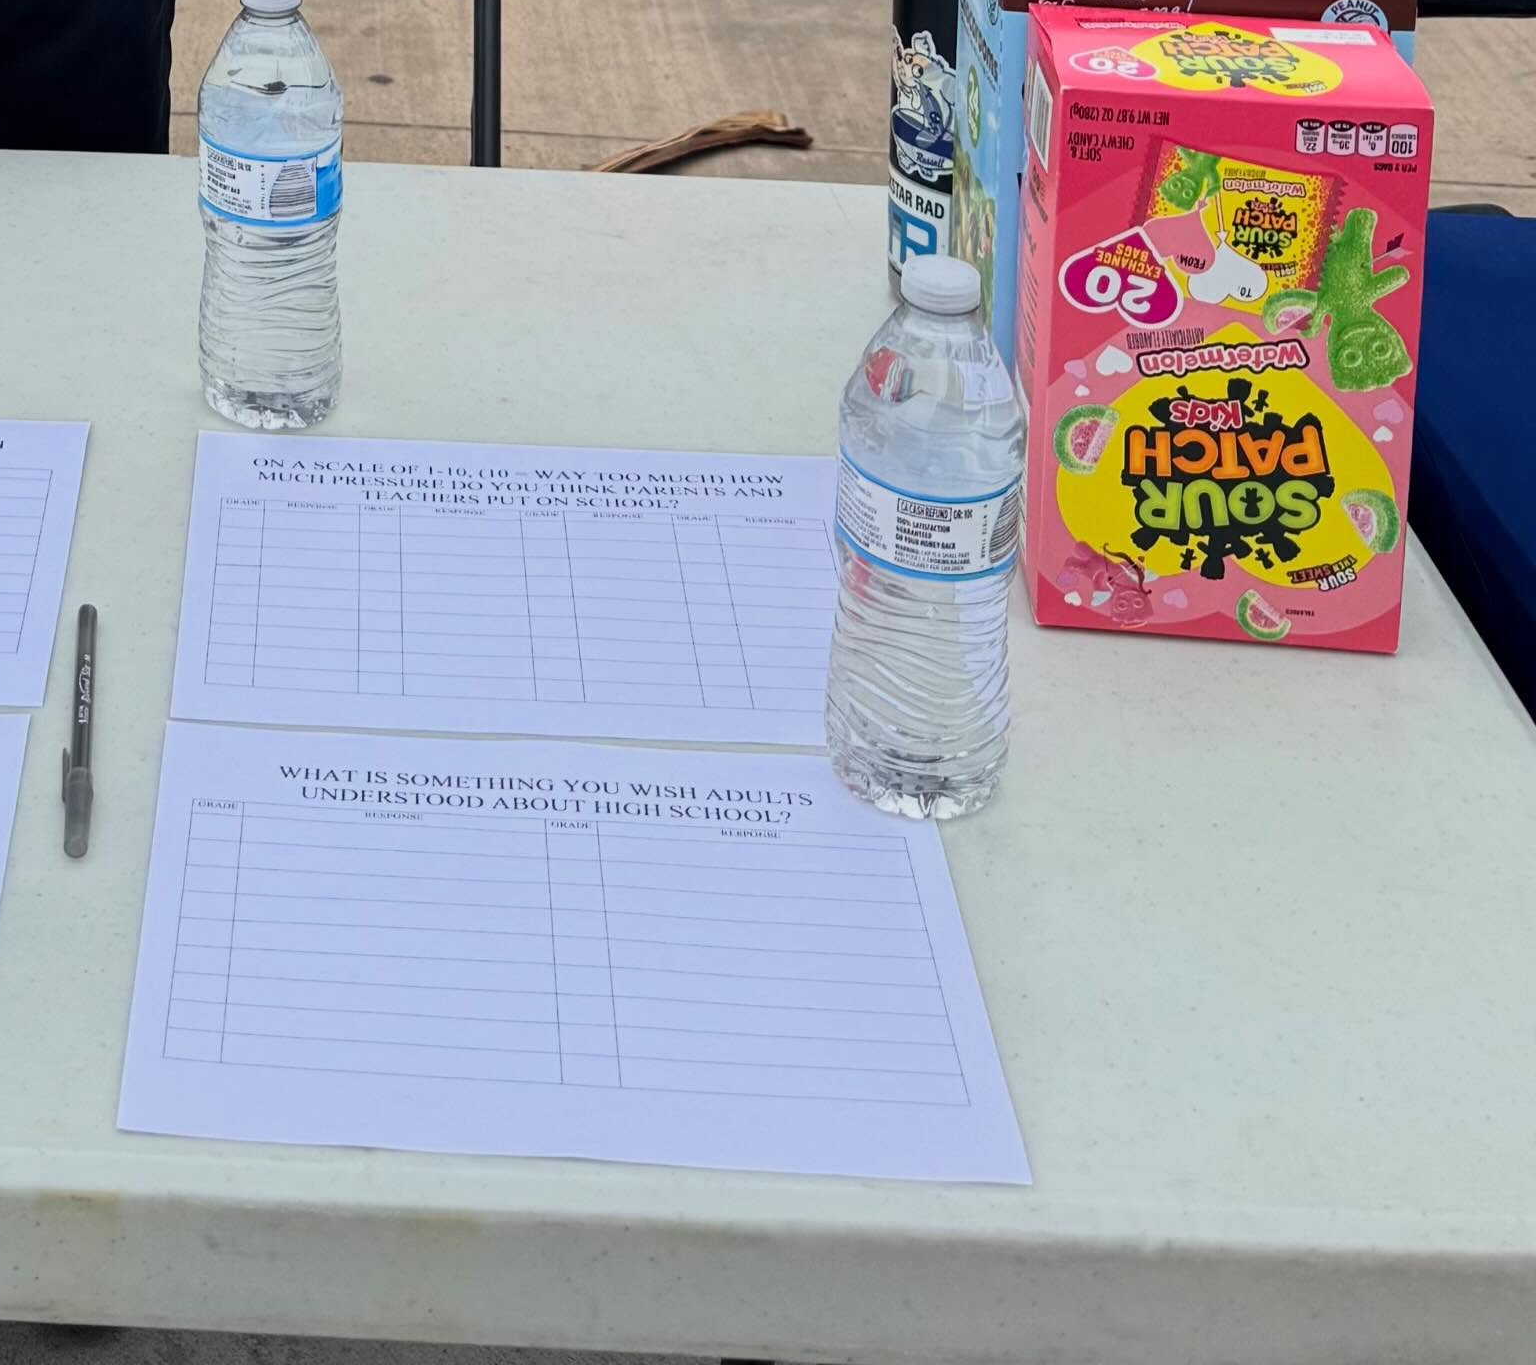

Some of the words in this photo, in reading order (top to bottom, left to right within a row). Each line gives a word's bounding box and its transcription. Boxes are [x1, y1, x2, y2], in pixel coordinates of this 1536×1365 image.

[1330, 0, 1379, 16] PEANUT
[1159, 38, 1291, 57] PATCH
[1177, 50, 1294, 73] SOUR
[1069, 102, 1098, 119] (280g)
[1115, 108, 1134, 122] 9.87
[1136, 109, 1149, 123] WT
[1150, 110, 1169, 124] NET
[1066, 131, 1098, 146] CANDY
[1100, 134, 1133, 149] CHEWY
[1390, 139, 1413, 154] 100
[916, 152, 944, 168] Russell
[1078, 146, 1101, 160] SOFT
[1222, 178, 1304, 196] Watermelon
[916, 195, 944, 219] RAD
[1232, 207, 1296, 228] PATCH
[1232, 224, 1292, 247] SOUR
[1113, 242, 1148, 261] BAGS
[1093, 247, 1161, 277] EXCHANGE
[1084, 268, 1157, 313] 20
[1140, 343, 1304, 374] Watermelon
[1169, 399, 1241, 429] Kids
[1127, 424, 1325, 479] PATCH
[252, 459, 284, 467] ON
[312, 461, 384, 475] SCALE
[390, 465, 416, 475] OF
[534, 469, 586, 481] WAY
[600, 473, 640, 481] TOO
[730, 475, 782, 483] HOW
[258, 471, 324, 485] MUCH
[332, 473, 444, 489] PRESSURE
[452, 481, 484, 489] DO
[490, 481, 538, 491] YOU
[550, 483, 616, 493] THINK
[624, 485, 726, 501] PARENTS
[734, 487, 782, 497] AND
[366, 491, 480, 505] TEACHERS
[488, 495, 530, 505] PUT
[536, 497, 568, 507] ON
[576, 497, 678, 509] SCHOOL?
[1135, 477, 1318, 529] SOUR
[926, 507, 948, 519] REFUND
[913, 521, 950, 533] SATISFACTION
[1317, 567, 1356, 590] SOUR
[280, 765, 358, 783] WHAT
[366, 771, 388, 783] IS
[394, 772, 554, 793] SOMETHING
[562, 779, 620, 795] YOU
[630, 783, 696, 799] WISH
[704, 789, 812, 809] ADULTS
[302, 785, 484, 807] UNDERSTOOD
[492, 797, 586, 813] ABOUT
[594, 801, 660, 817] HIGH
[670, 805, 790, 823] SCHOOL?
